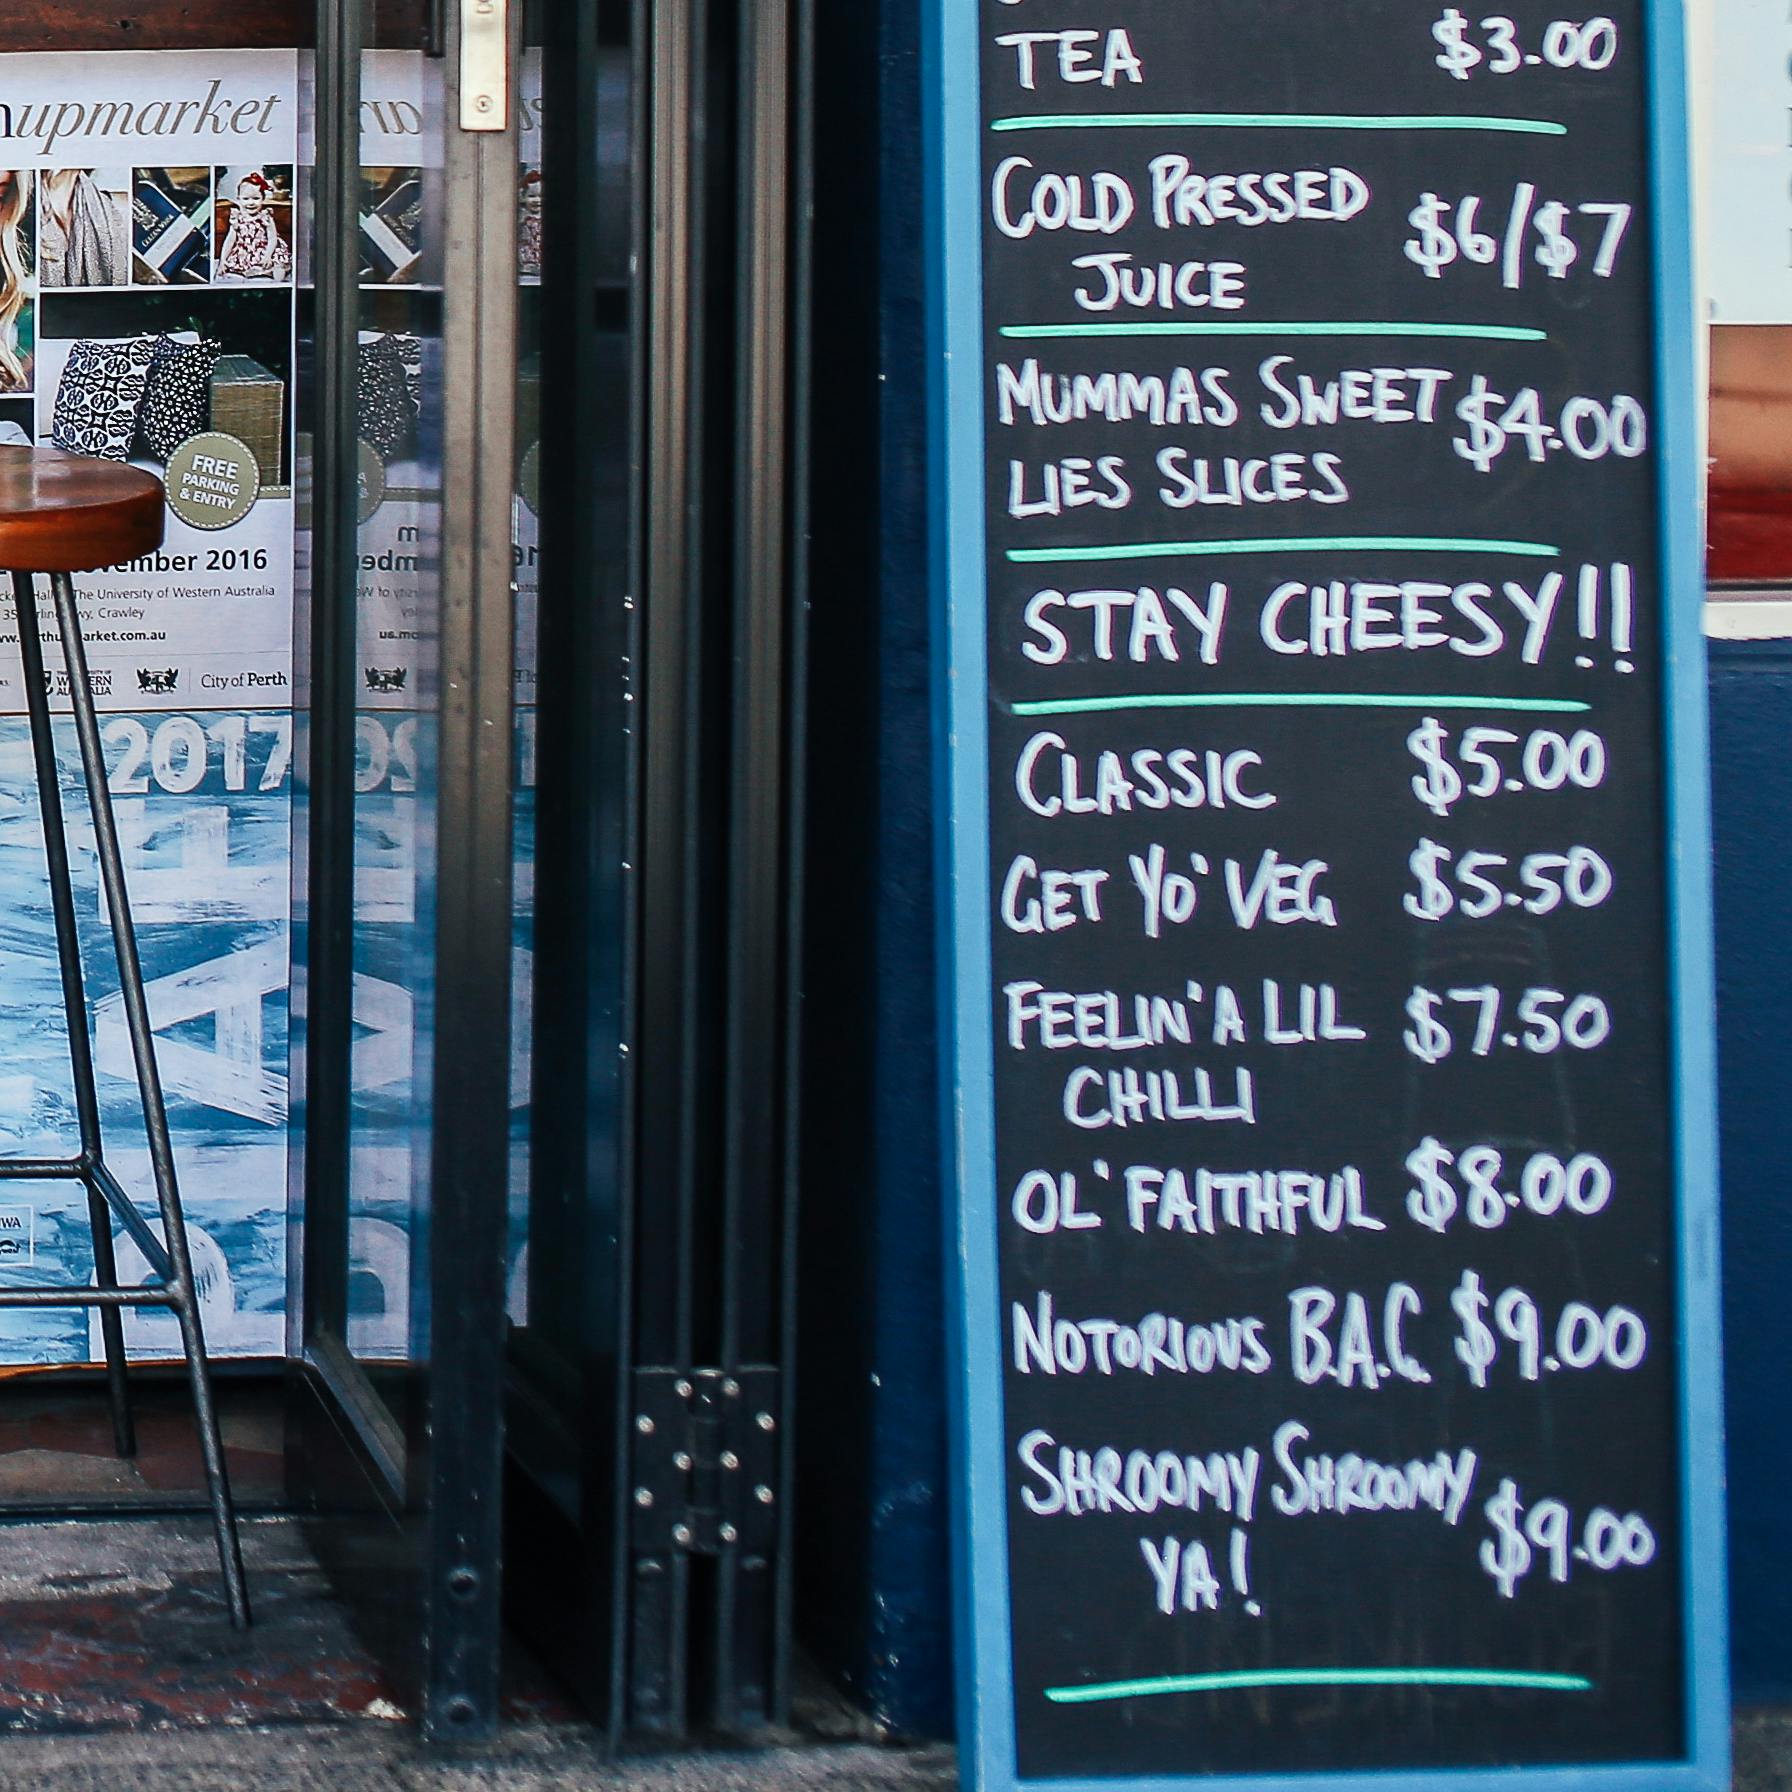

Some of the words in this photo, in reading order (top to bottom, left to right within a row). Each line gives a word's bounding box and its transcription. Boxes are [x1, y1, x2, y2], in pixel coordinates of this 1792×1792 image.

[994, 27, 1143, 90] TEA
[1431, 8, 1617, 81] $3.00
[991, 154, 1133, 239] COLD
[1148, 153, 1370, 230] PRESSED
[1404, 182, 1632, 290] $6/$7
[1073, 252, 1246, 311] JUICE
[996, 357, 1239, 429] MUMMAS
[1258, 354, 1454, 431] SWEET
[1452, 374, 1648, 474] $4.00
[182, 471, 240, 497] PARKING
[191, 454, 238, 479] FREE
[193, 488, 237, 511] ENTRY
[1008, 455, 1132, 518] LIES
[1157, 447, 1350, 511] SLICES
[74, 590, 92, 601] The
[97, 588, 152, 601] University
[156, 587, 170, 598] of
[173, 586, 221, 598] Western
[225, 585, 275, 597] Australia
[206, 548, 267, 570] 2016
[98, 607, 145, 620] Crawley
[1022, 581, 1228, 667] STAY
[1260, 562, 1636, 675] CHEESY!!
[201, 674, 227, 688] City
[231, 672, 243, 687] of
[246, 672, 287, 687] Perth
[105, 716, 291, 795] 2017
[1015, 731, 1278, 818] CLASSIC
[1407, 716, 1606, 817] $5.00
[1264, 978, 1367, 1045] LIL
[1403, 985, 1612, 1065] $7.50
[1064, 1067, 1256, 1131] CHILLI
[1123, 1165, 1388, 1236] FAITHFUL
[1406, 1135, 1613, 1234] $8.00
[1012, 1290, 1272, 1377] NOTORIOUS
[1452, 1270, 1648, 1388] $9.00
[1017, 1429, 1261, 1522] SHROOMY
[1272, 1421, 1478, 1526] SHROOMY
[1140, 1529, 1264, 1616] YA!
[1479, 1477, 1656, 1600] $9.00
